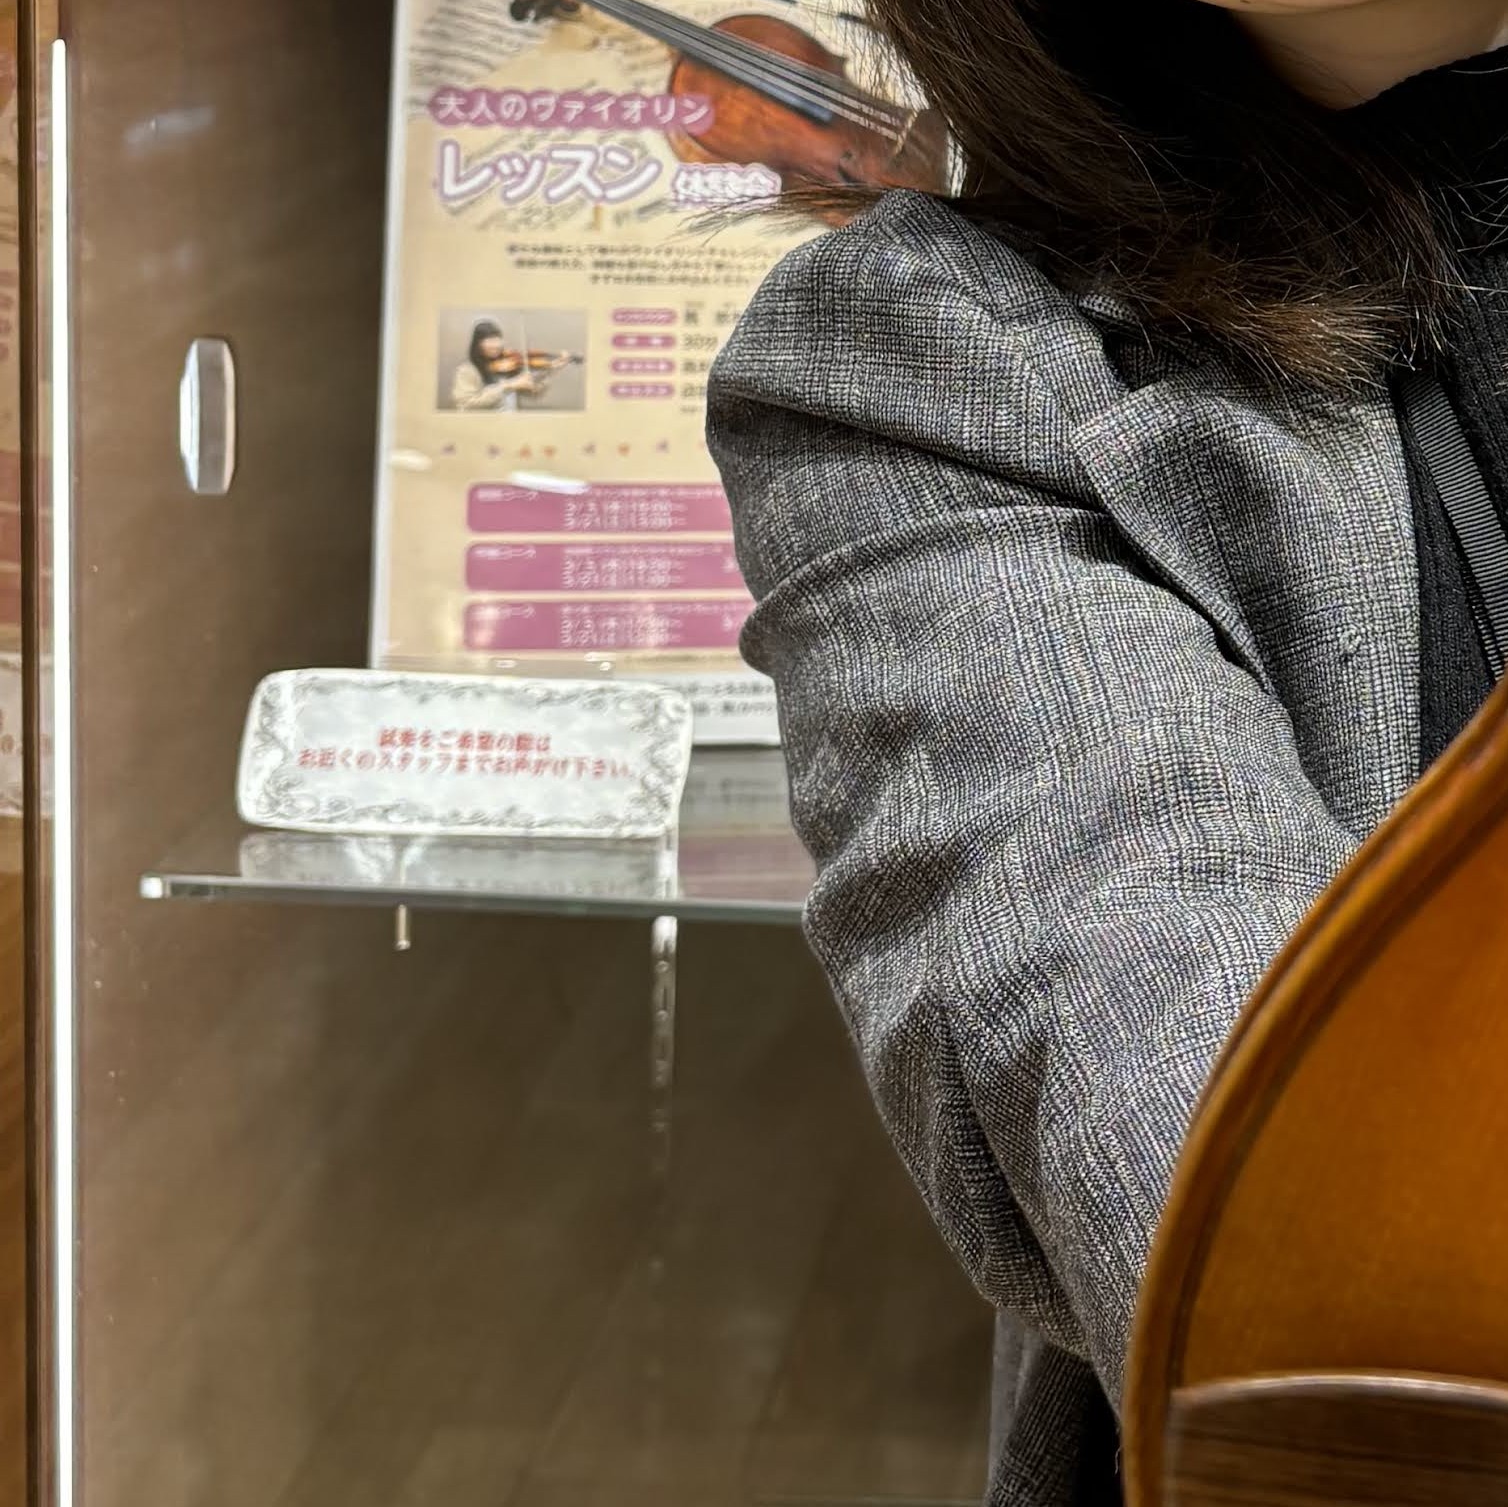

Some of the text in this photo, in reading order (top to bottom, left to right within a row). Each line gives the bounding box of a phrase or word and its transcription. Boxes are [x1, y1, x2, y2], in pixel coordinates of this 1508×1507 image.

[438, 94, 712, 127] 大人のヴァイオリン
[439, 140, 663, 203] レッスン
